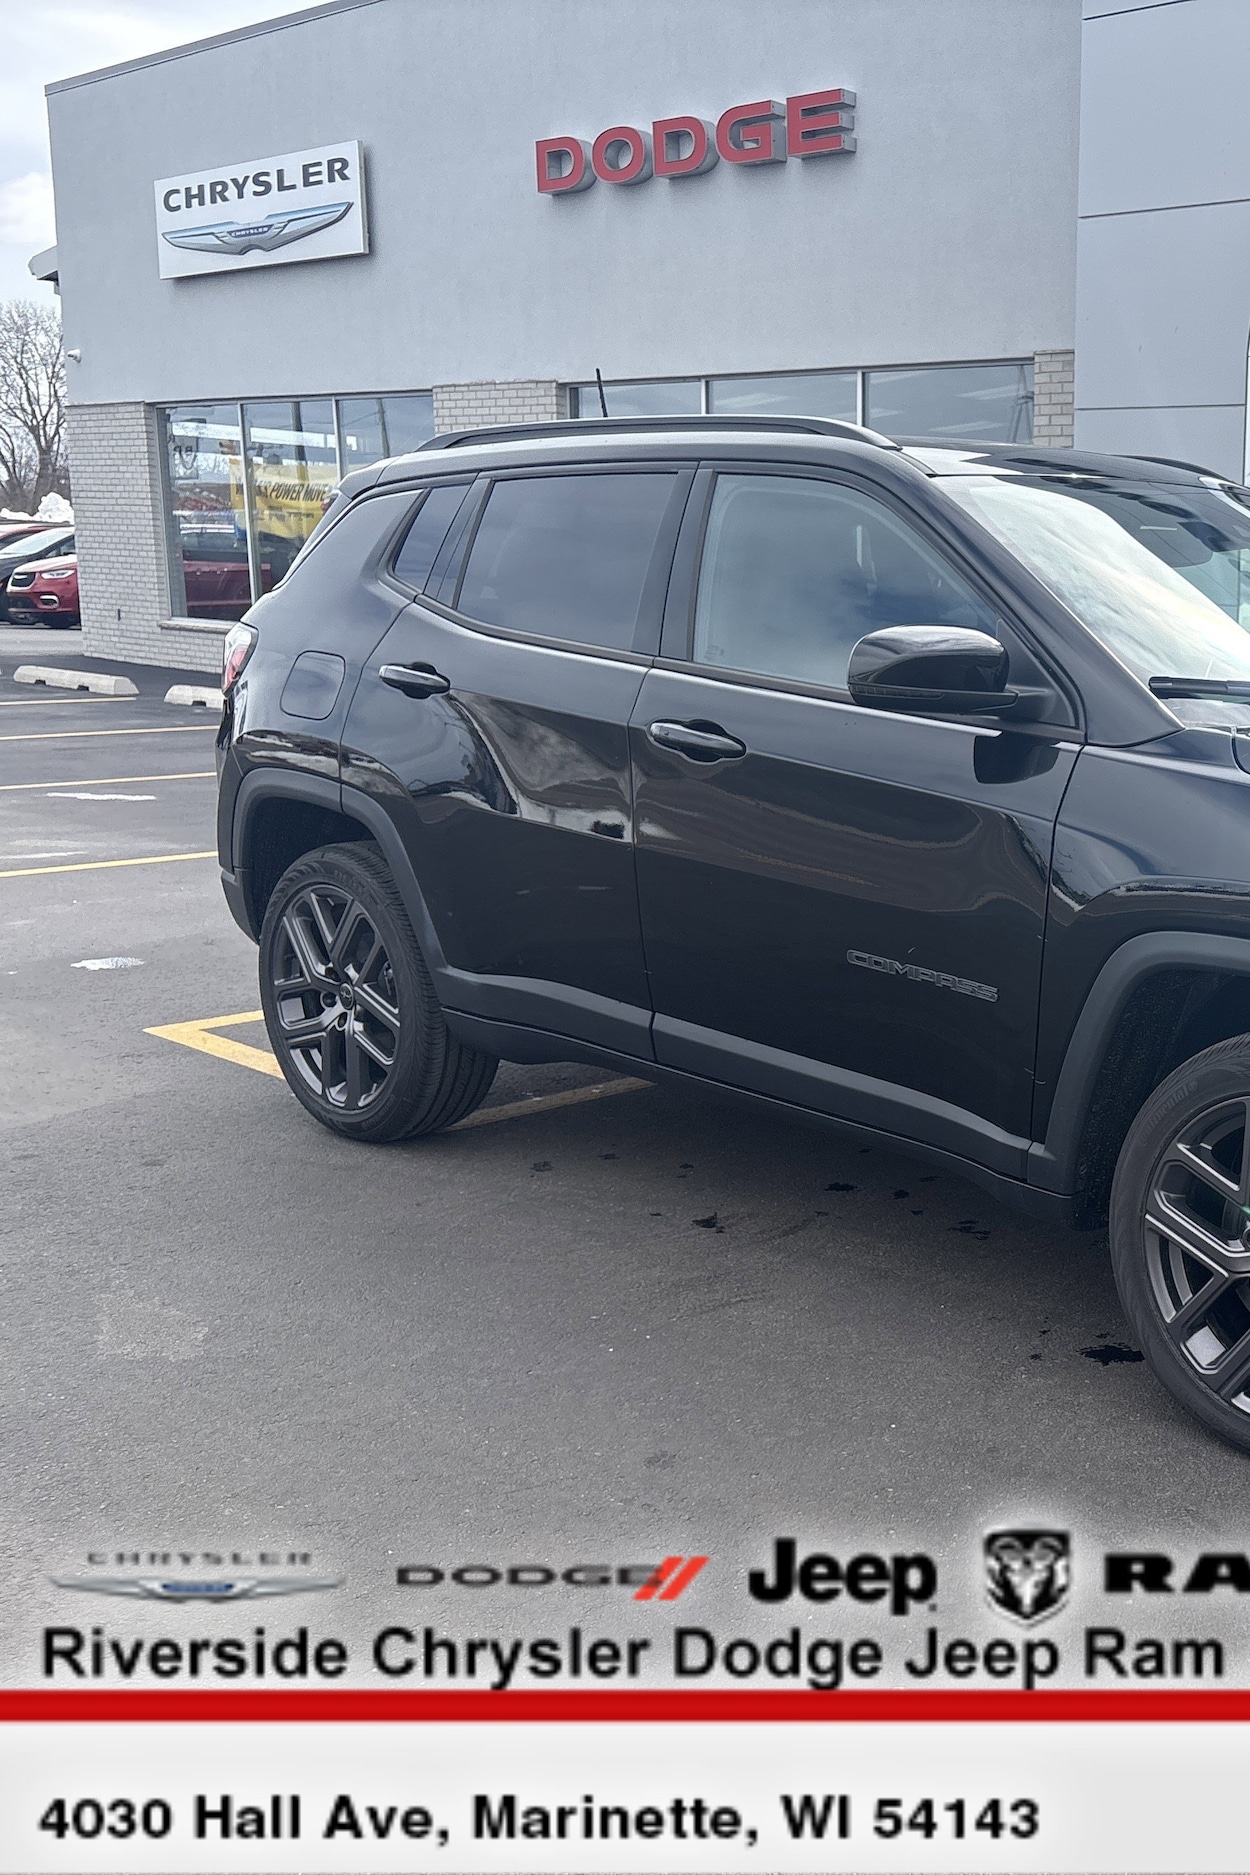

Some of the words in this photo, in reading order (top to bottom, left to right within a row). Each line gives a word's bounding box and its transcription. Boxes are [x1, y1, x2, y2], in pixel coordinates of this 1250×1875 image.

[535, 88, 856, 194] DODGE
[163, 157, 351, 213] CHRYSLER
[230, 226, 270, 237] CHRYSLER
[270, 482, 305, 501] POWER
[846, 949, 999, 1003] COMPASS
